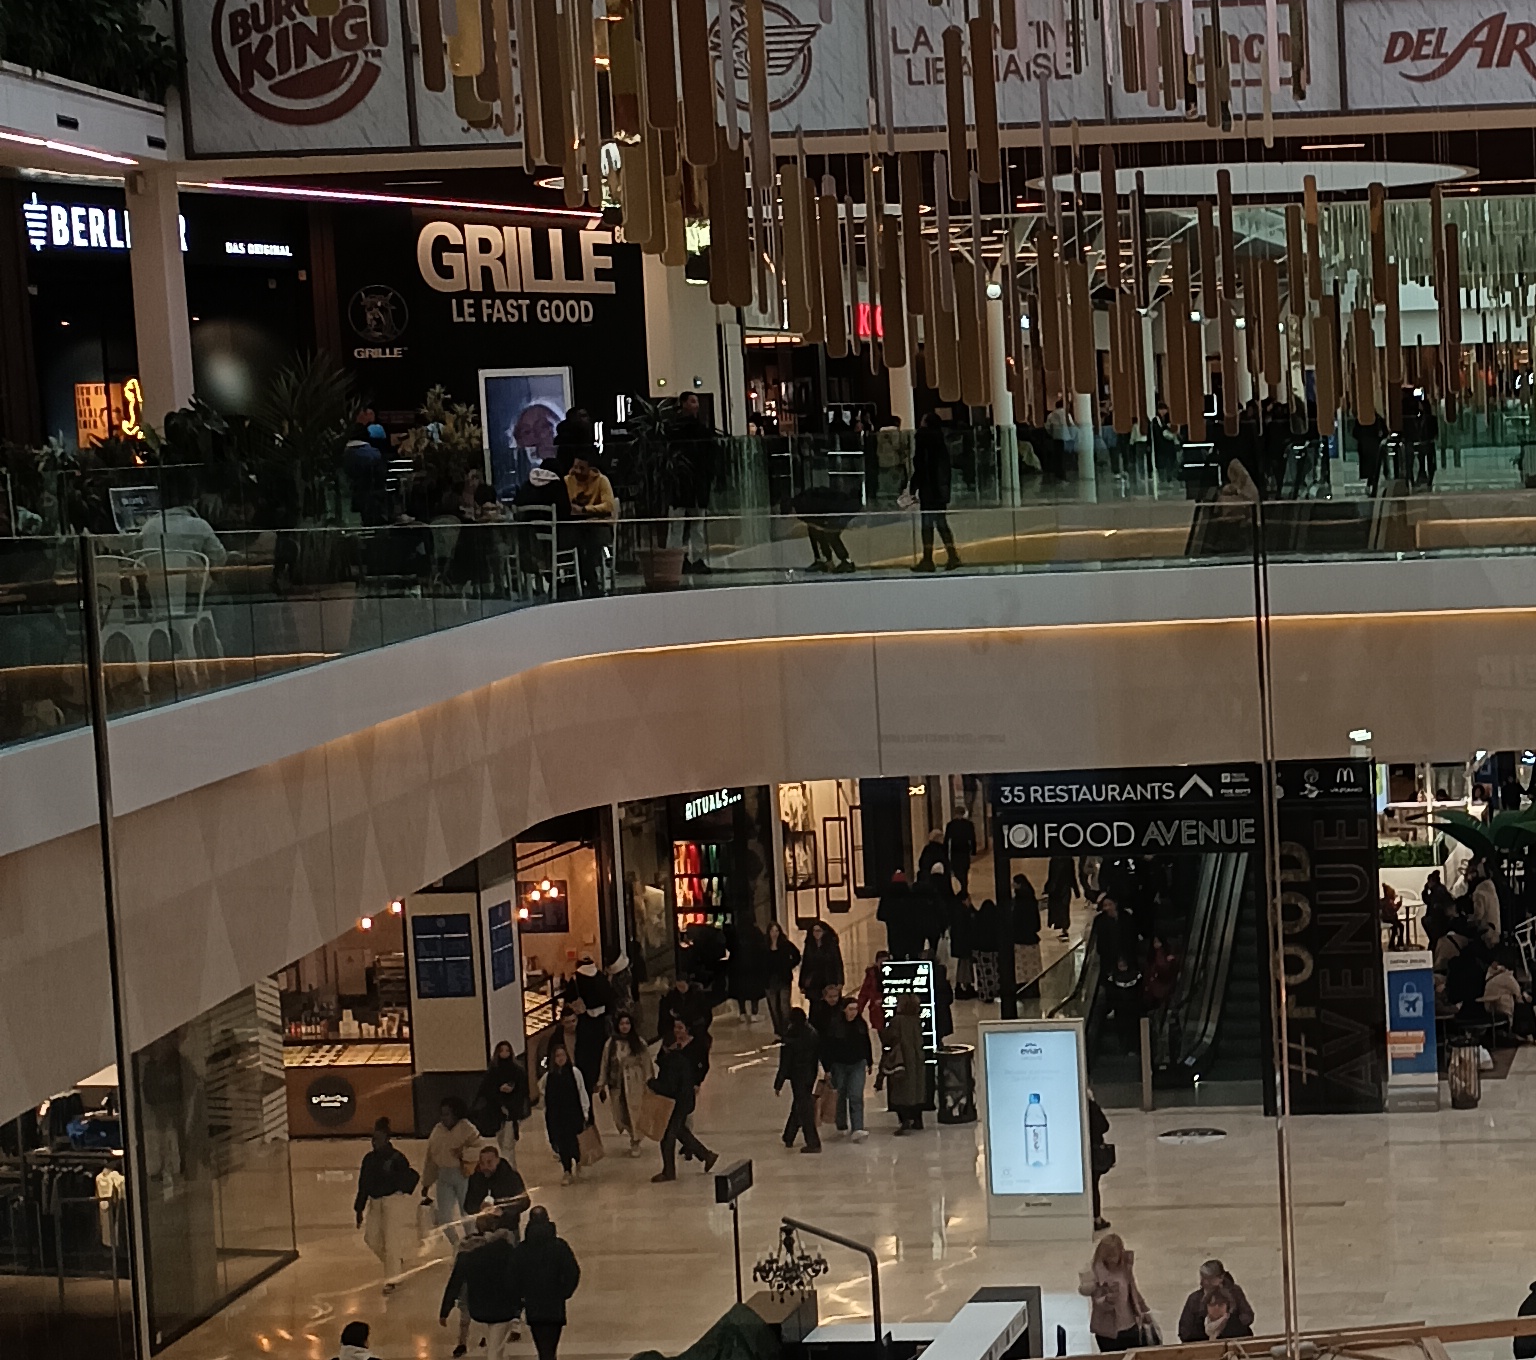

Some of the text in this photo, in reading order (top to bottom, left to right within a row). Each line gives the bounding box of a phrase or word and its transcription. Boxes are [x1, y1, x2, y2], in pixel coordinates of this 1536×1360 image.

[238, 4, 370, 93] KING
[891, 25, 934, 55] LA
[1383, 26, 1449, 65] DEL
[50, 204, 189, 252] BERLIR
[417, 218, 616, 294] GRILLÉ
[452, 298, 594, 323] LE FAST GOOD
[1000, 782, 1176, 804] 35 RESTAURANTS
[1044, 818, 1256, 849] FOOD AVENUE
